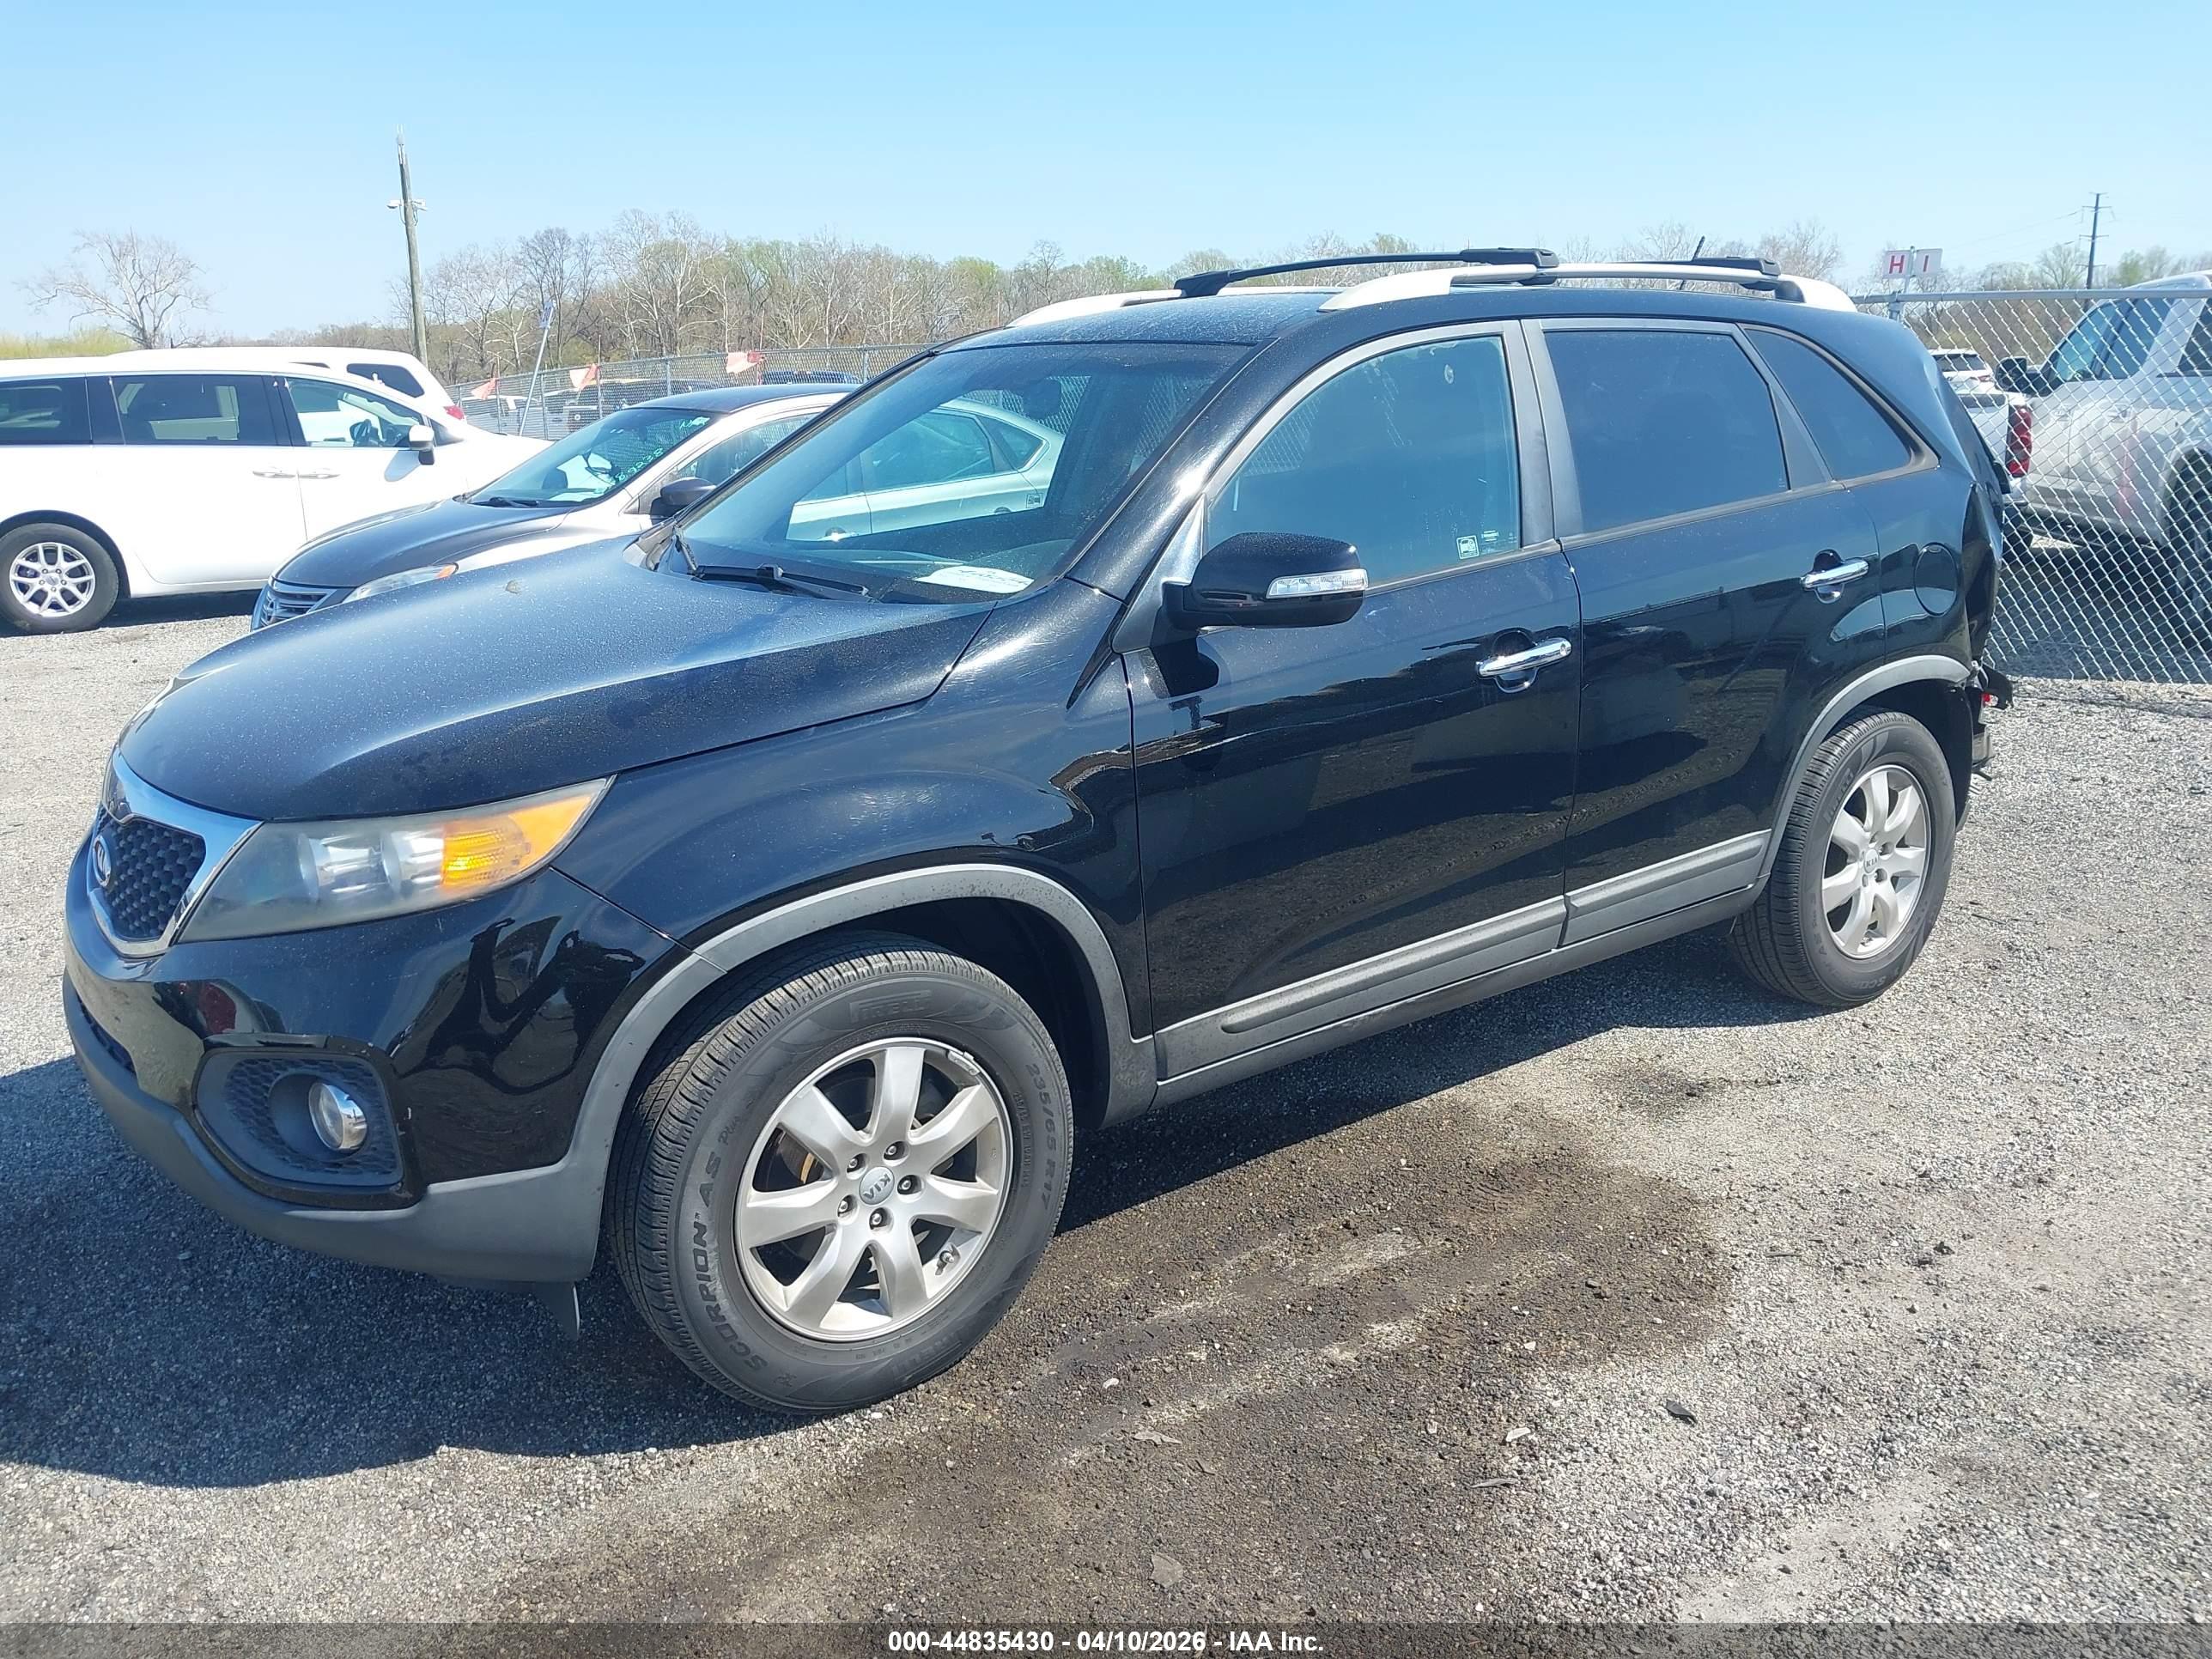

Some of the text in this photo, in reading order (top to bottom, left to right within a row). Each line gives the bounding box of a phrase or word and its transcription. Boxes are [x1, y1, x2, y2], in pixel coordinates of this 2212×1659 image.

[1888, 254, 1905, 274] H
[1866, 856, 1879, 867] KIA
[1025, 1062, 1058, 1210] 235/65 R17
[862, 1173, 891, 1200] KIA
